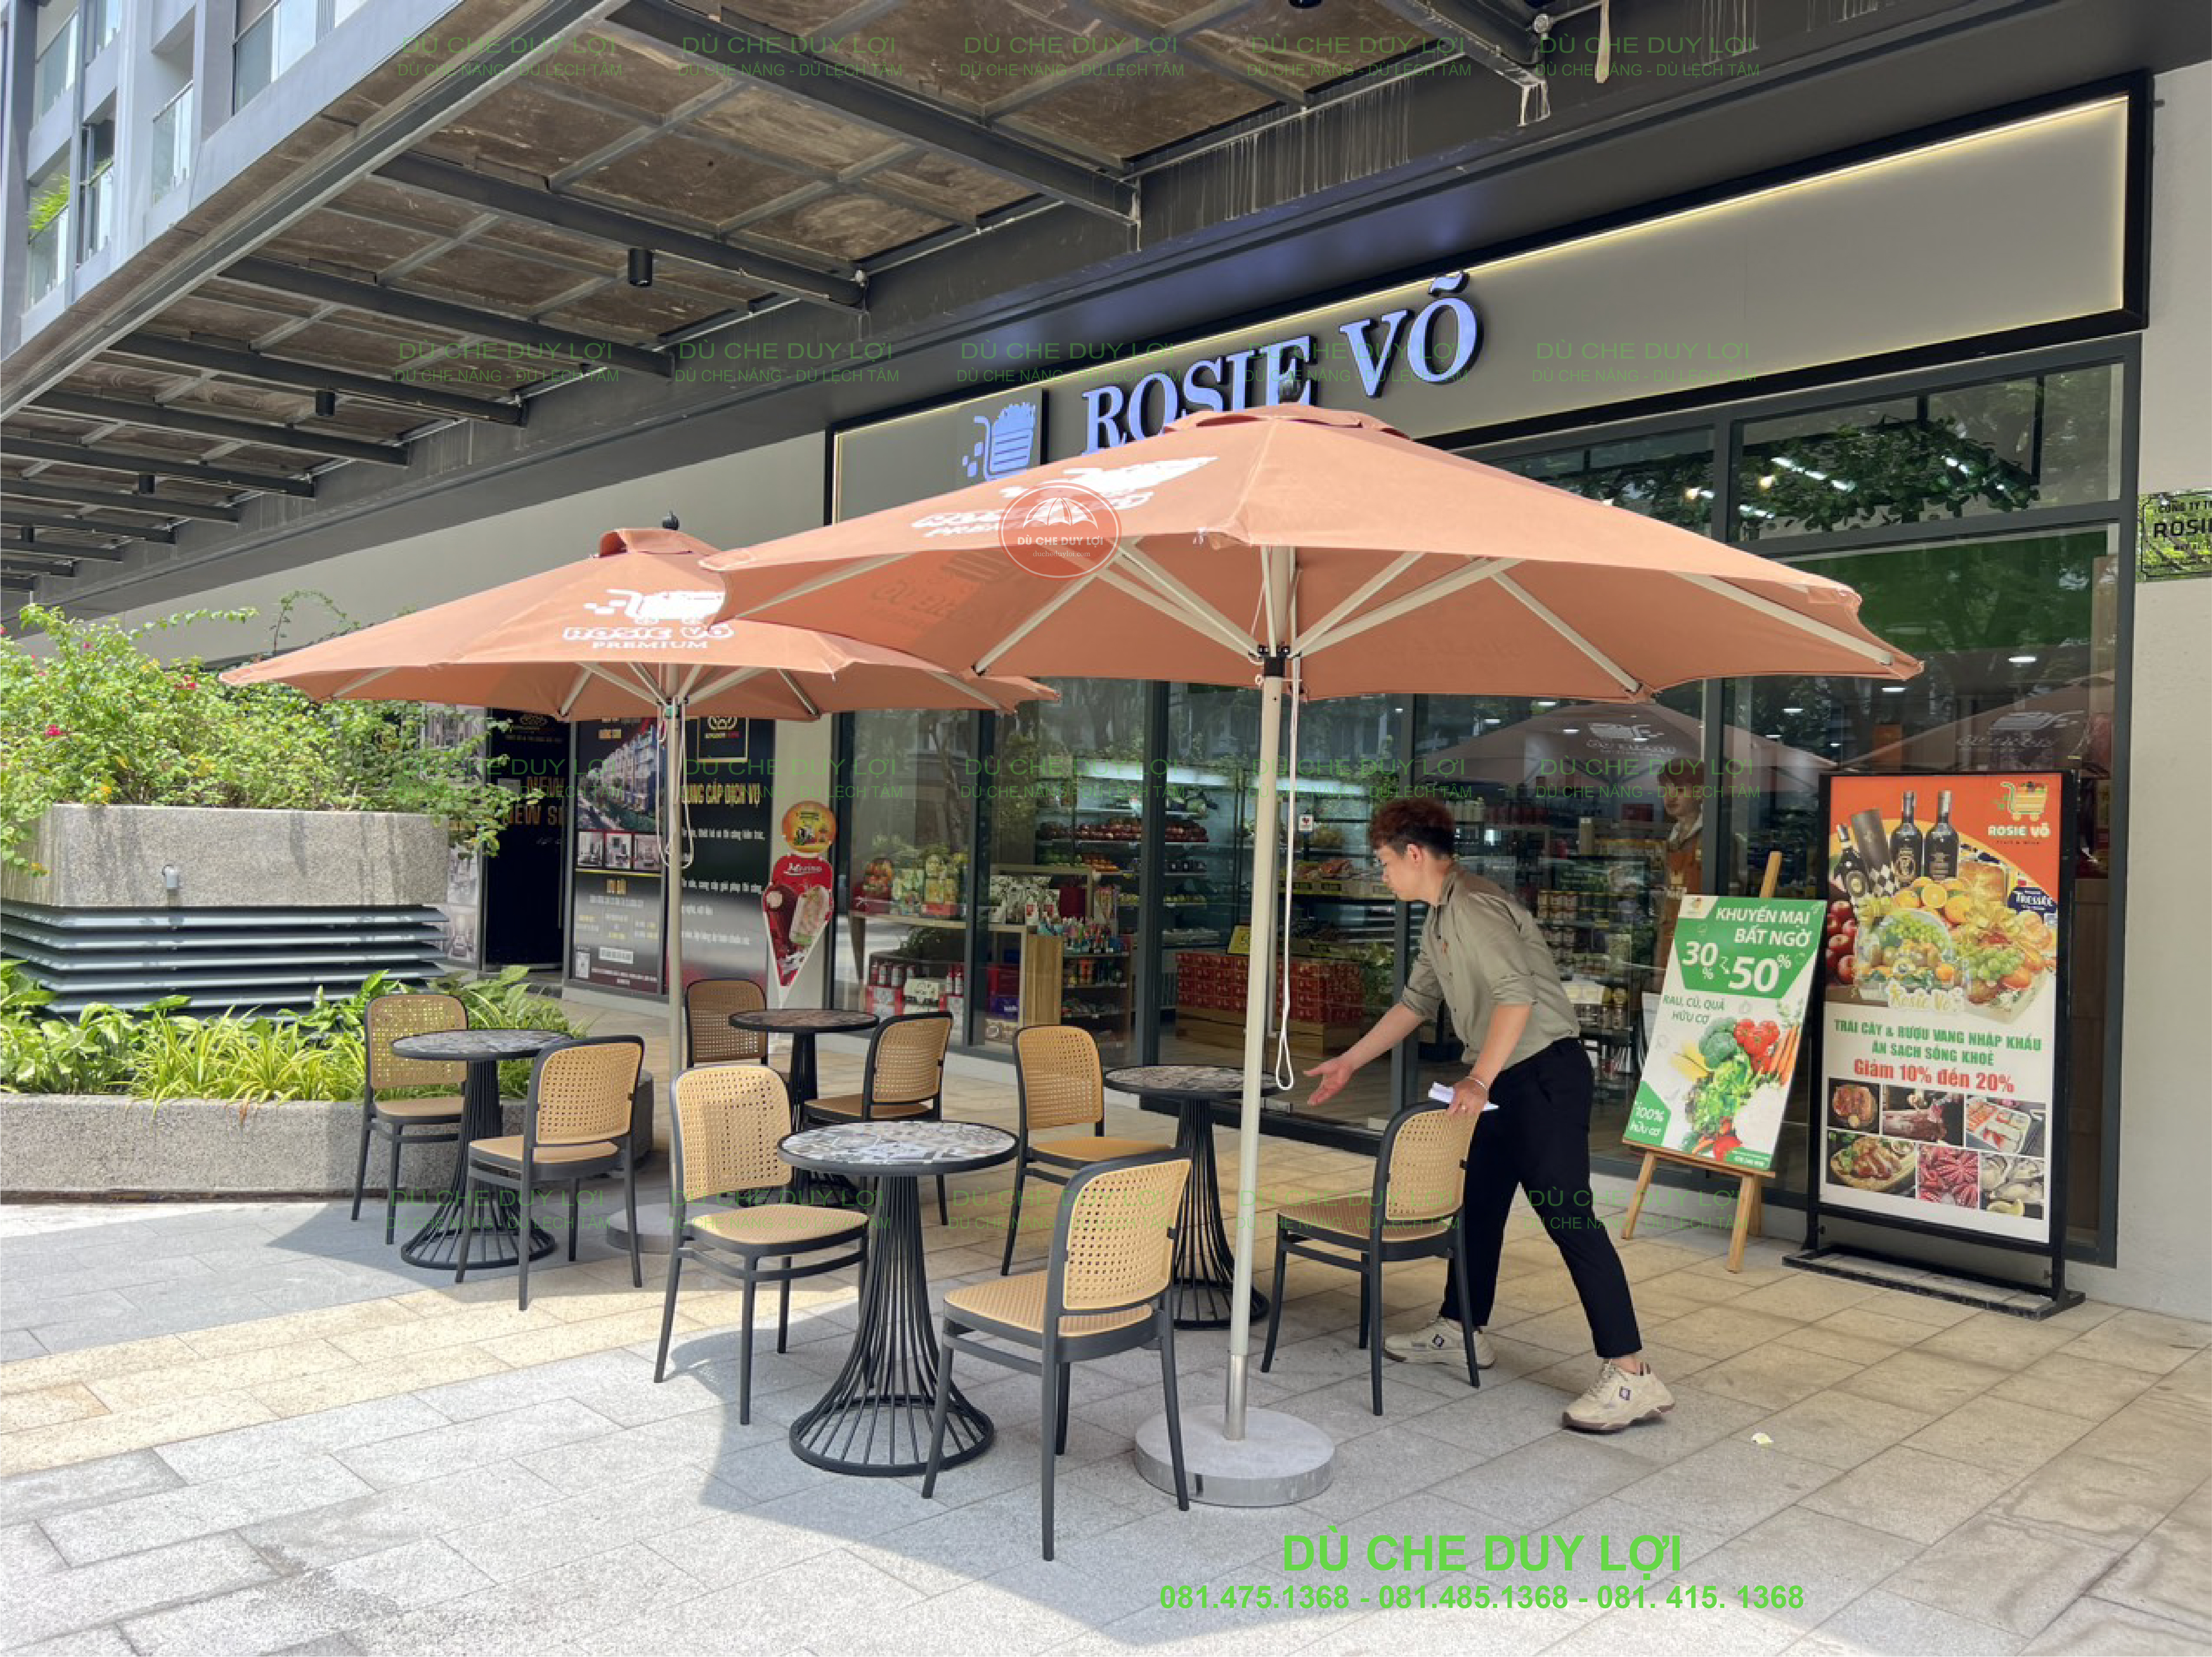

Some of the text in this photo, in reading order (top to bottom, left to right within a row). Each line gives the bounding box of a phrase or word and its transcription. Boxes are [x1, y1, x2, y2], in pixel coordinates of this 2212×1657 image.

[1081, 272, 1482, 454] ROSIE VÕ
[1716, 905, 1811, 928] KHUYẾN MẠI
[1734, 924, 1813, 948] BẤT NGỜ
[1933, 1029, 1965, 1044] VANG
[1854, 1058, 2014, 1093] Giảm 10% đến 20%
